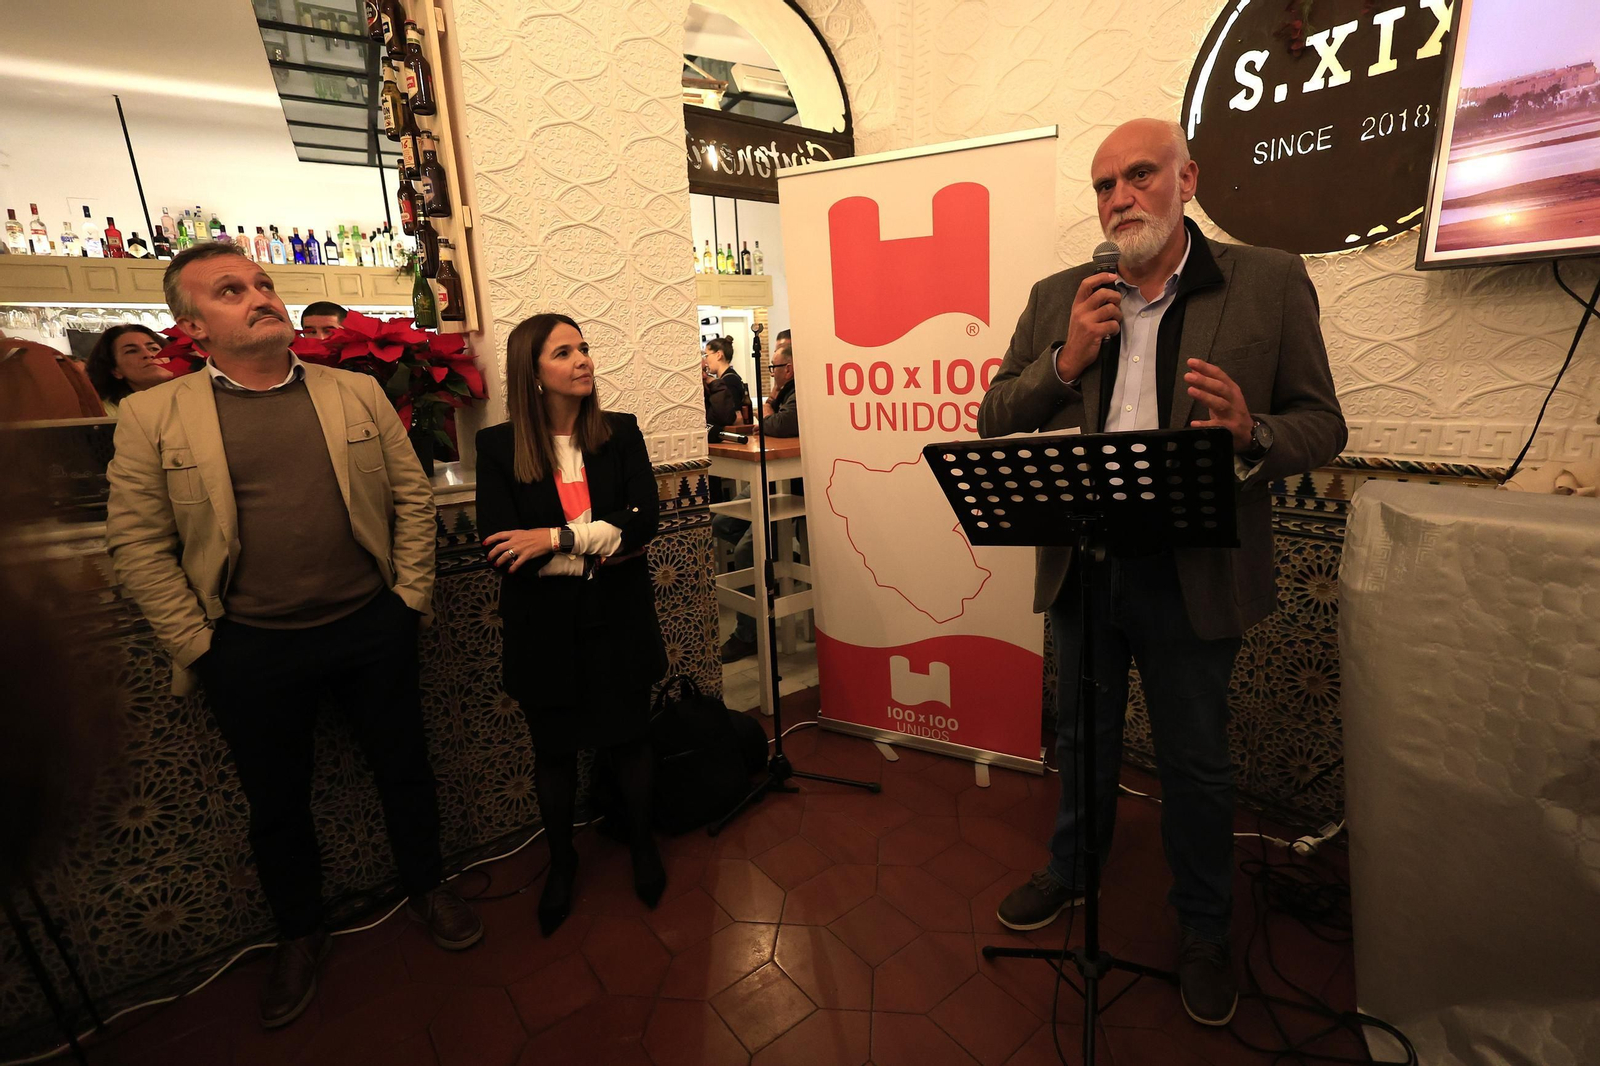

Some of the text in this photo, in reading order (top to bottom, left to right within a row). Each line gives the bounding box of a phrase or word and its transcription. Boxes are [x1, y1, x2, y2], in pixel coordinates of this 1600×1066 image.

[1252, 124, 1334, 165] SINCE
[850, 401, 981, 433] UNIDOS
[896, 721, 950, 742] UNIDOS
